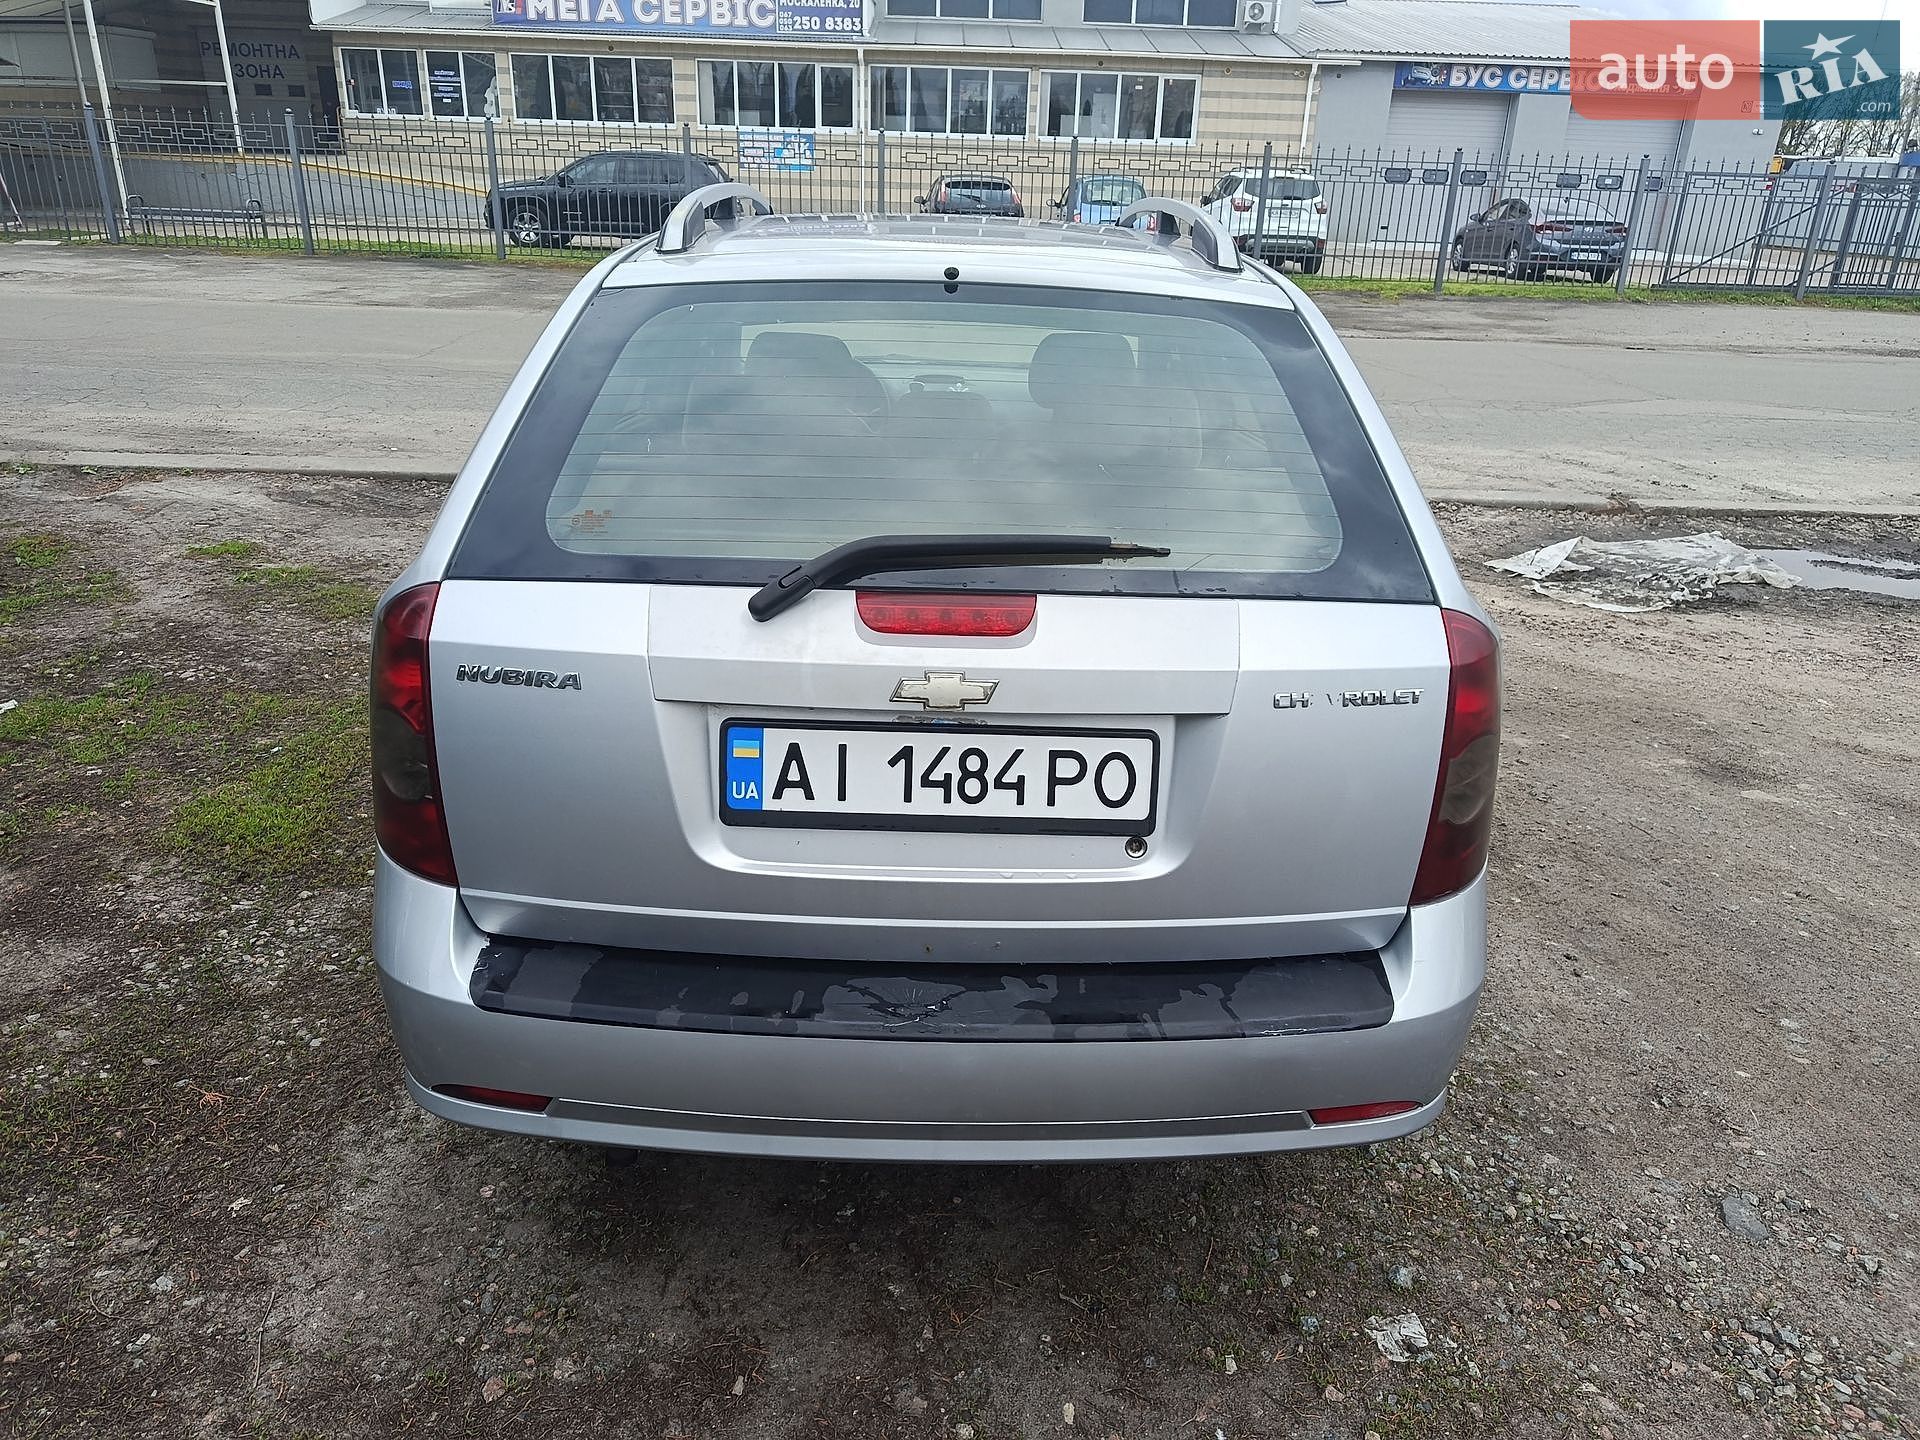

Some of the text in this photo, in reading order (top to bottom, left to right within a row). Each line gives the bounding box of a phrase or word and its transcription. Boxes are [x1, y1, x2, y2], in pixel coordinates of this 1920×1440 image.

[632, 0, 776, 28] СЕРВІС
[793, 16, 862, 31] 250 8383
[200, 41, 300, 59] РЕМОНТНА
[233, 63, 285, 79] ЗОНА
[1450, 65, 1503, 88] БУС
[456, 663, 582, 691] NUBIRA
[1273, 687, 1425, 709] CHROLET
[772, 741, 1138, 809] AI 1484 PO
[731, 781, 759, 801] UA
